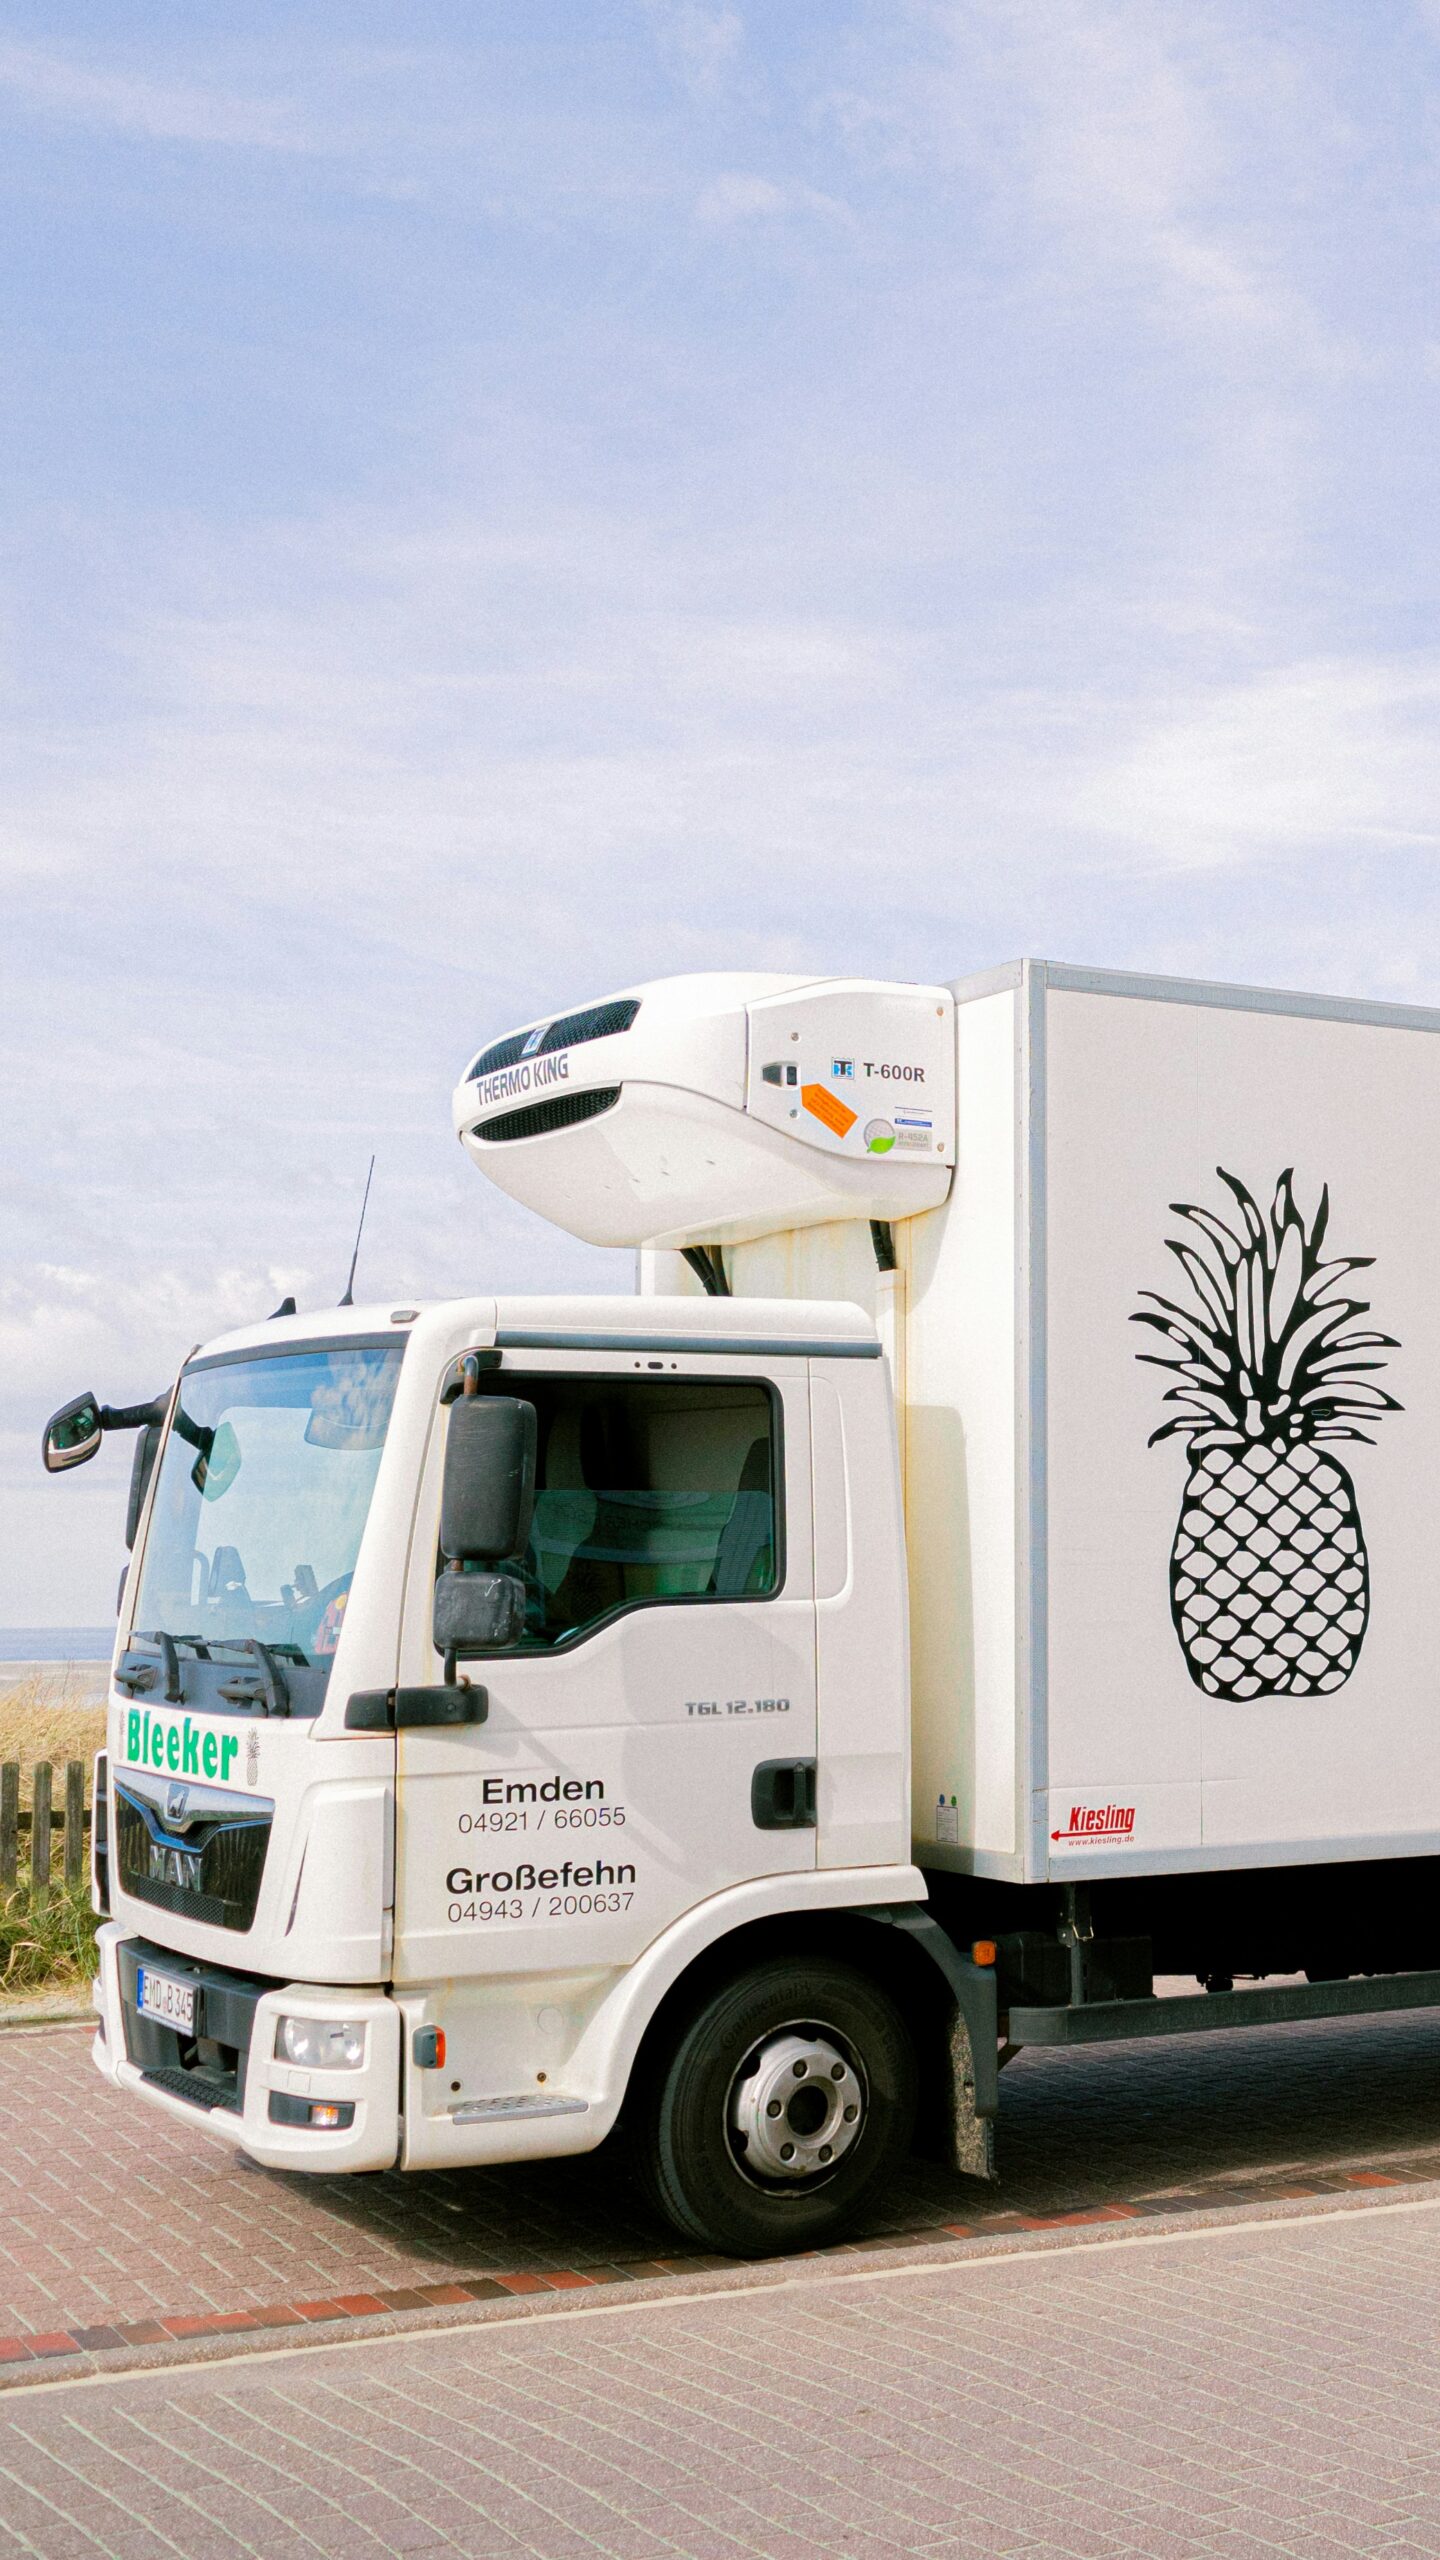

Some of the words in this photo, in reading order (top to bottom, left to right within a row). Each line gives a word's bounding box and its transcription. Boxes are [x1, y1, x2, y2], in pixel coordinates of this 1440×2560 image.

[477, 1066, 530, 1105] THERMO
[533, 1053, 569, 1088] KING
[863, 1062, 925, 1083] T-600R
[685, 1701, 722, 1716] TGL
[726, 1698, 790, 1715] 12.180
[127, 1708, 239, 1781] Bleeker
[482, 1776, 605, 1804] Emden
[458, 1811, 527, 1833] 04921
[536, 1810, 546, 1830] /
[554, 1806, 626, 1829] 66055
[1068, 1804, 1136, 1832] Kiesling
[1068, 1834, 1135, 1847] www.kiesling.de
[149, 1845, 203, 1893] MAN
[446, 1860, 636, 1894] Großefehn
[448, 1899, 523, 1923] 04943
[531, 1897, 541, 1918] /
[549, 1892, 634, 1916] 200637
